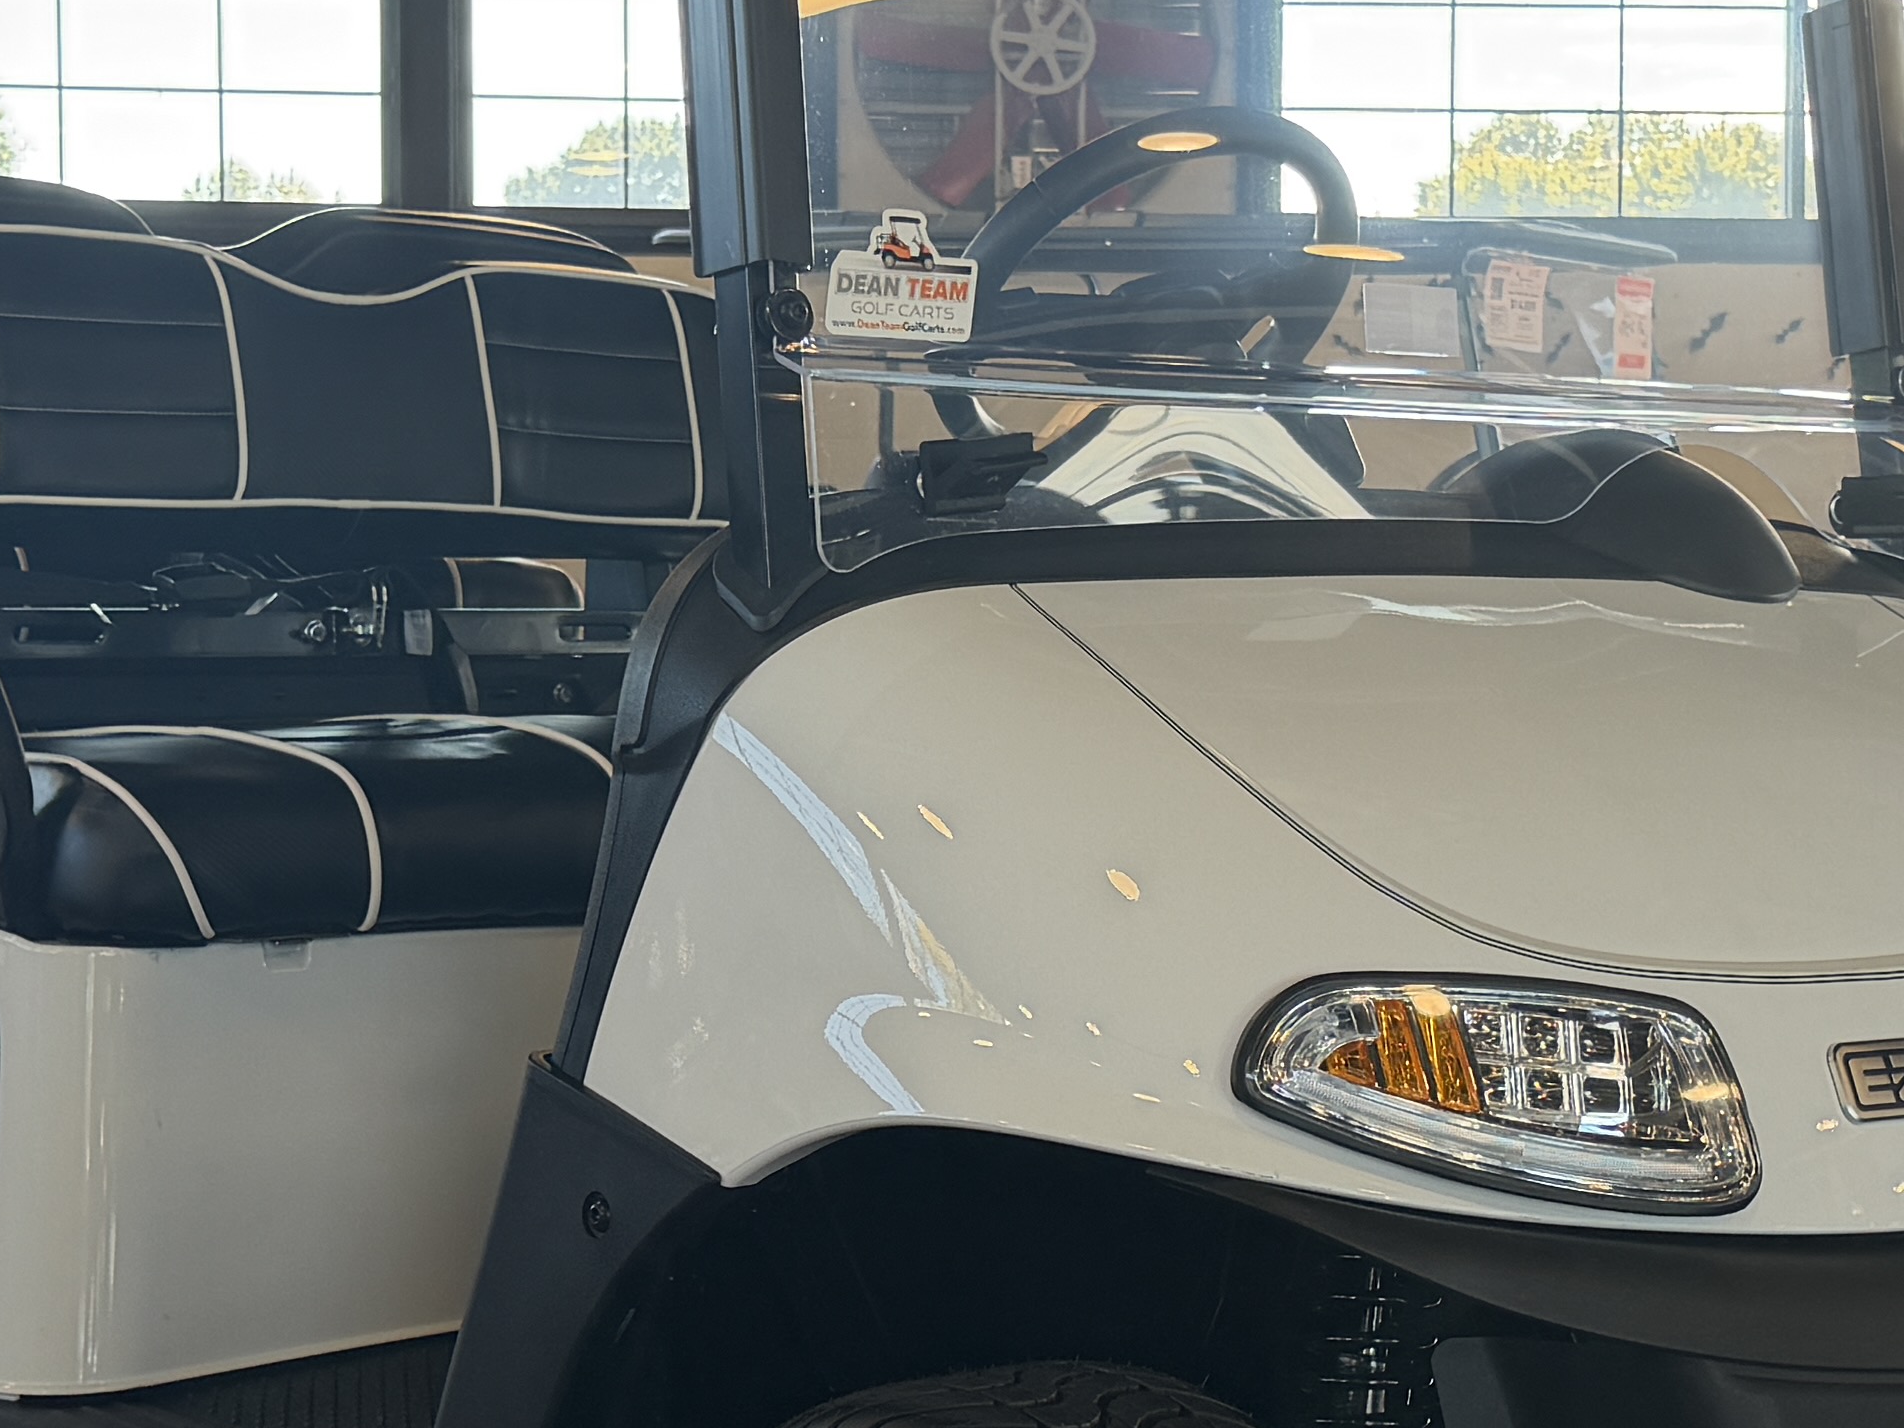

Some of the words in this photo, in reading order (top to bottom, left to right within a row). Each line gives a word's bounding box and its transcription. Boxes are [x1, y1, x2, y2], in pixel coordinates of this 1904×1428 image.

[835, 272, 901, 297] DEAN
[906, 276, 970, 301] TEAM
[851, 300, 895, 316] GOLF
[898, 303, 955, 320] CARTS
